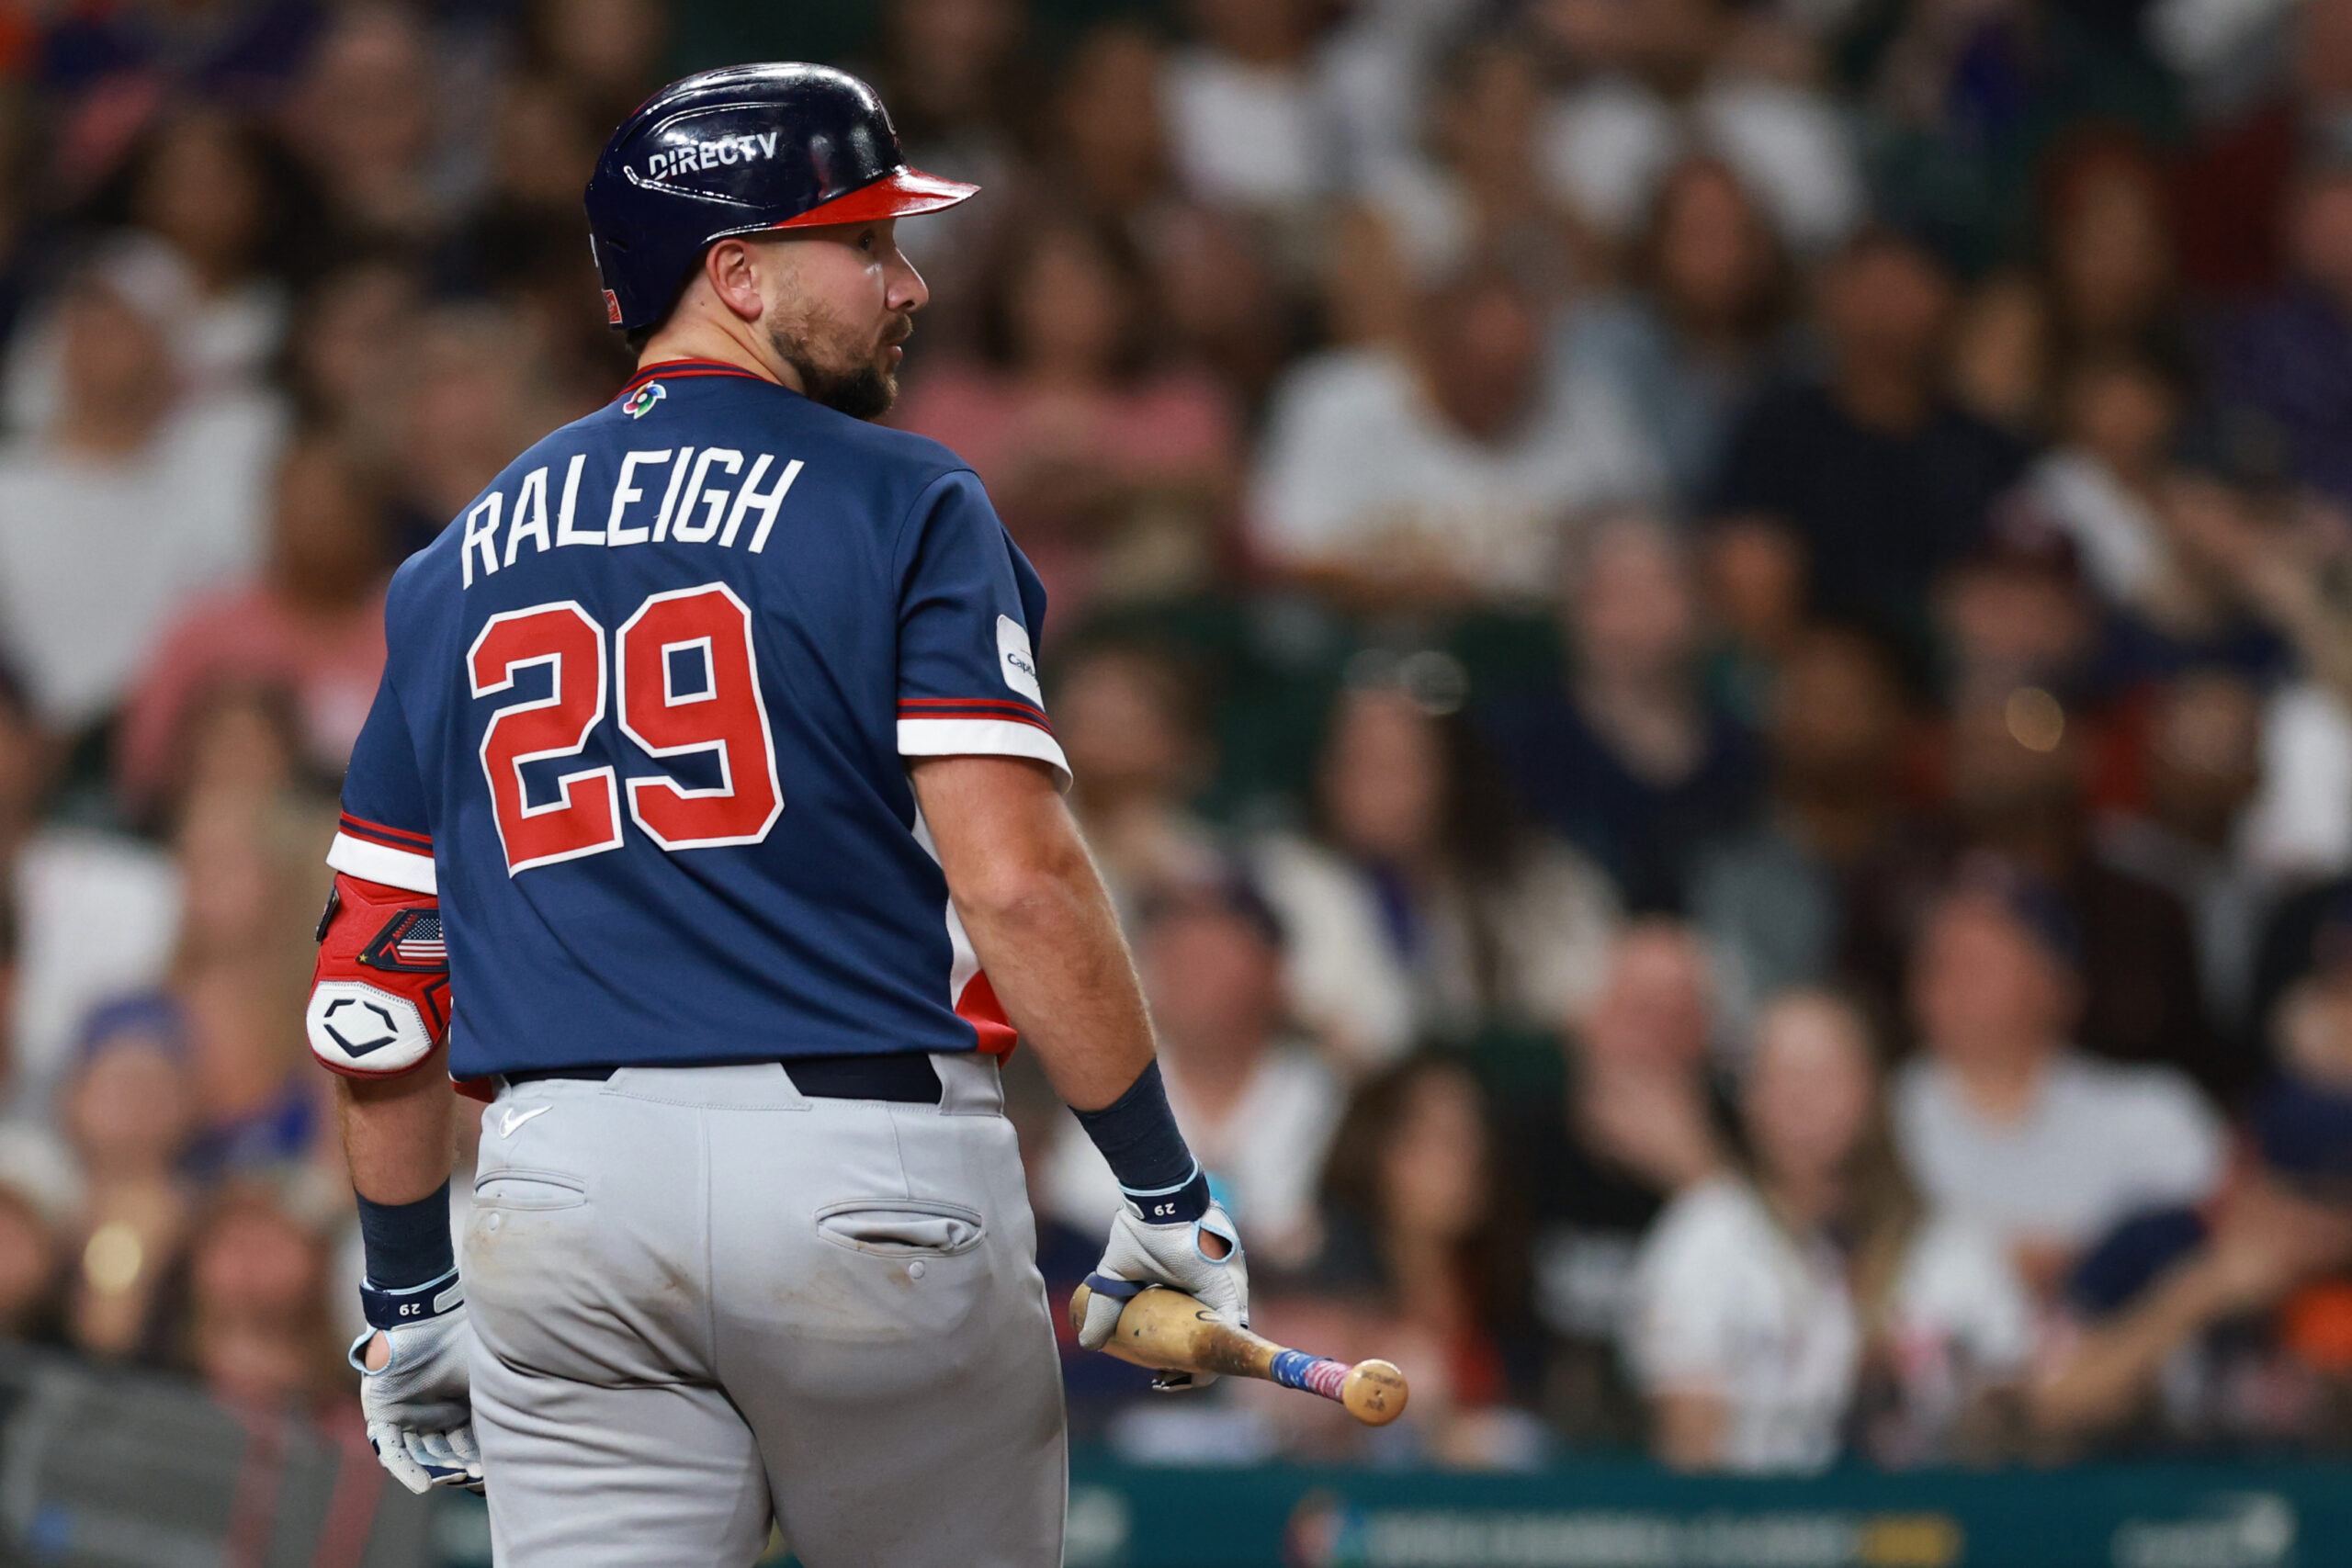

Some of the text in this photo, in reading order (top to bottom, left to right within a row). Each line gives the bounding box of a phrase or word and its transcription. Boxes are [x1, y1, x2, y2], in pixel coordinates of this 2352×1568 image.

[649, 131, 777, 180] DIRECTV
[461, 446, 805, 591] RALEIGH
[466, 581, 785, 879] 29
[1154, 1201, 1176, 1217] 29
[399, 1303, 421, 1316] 29
